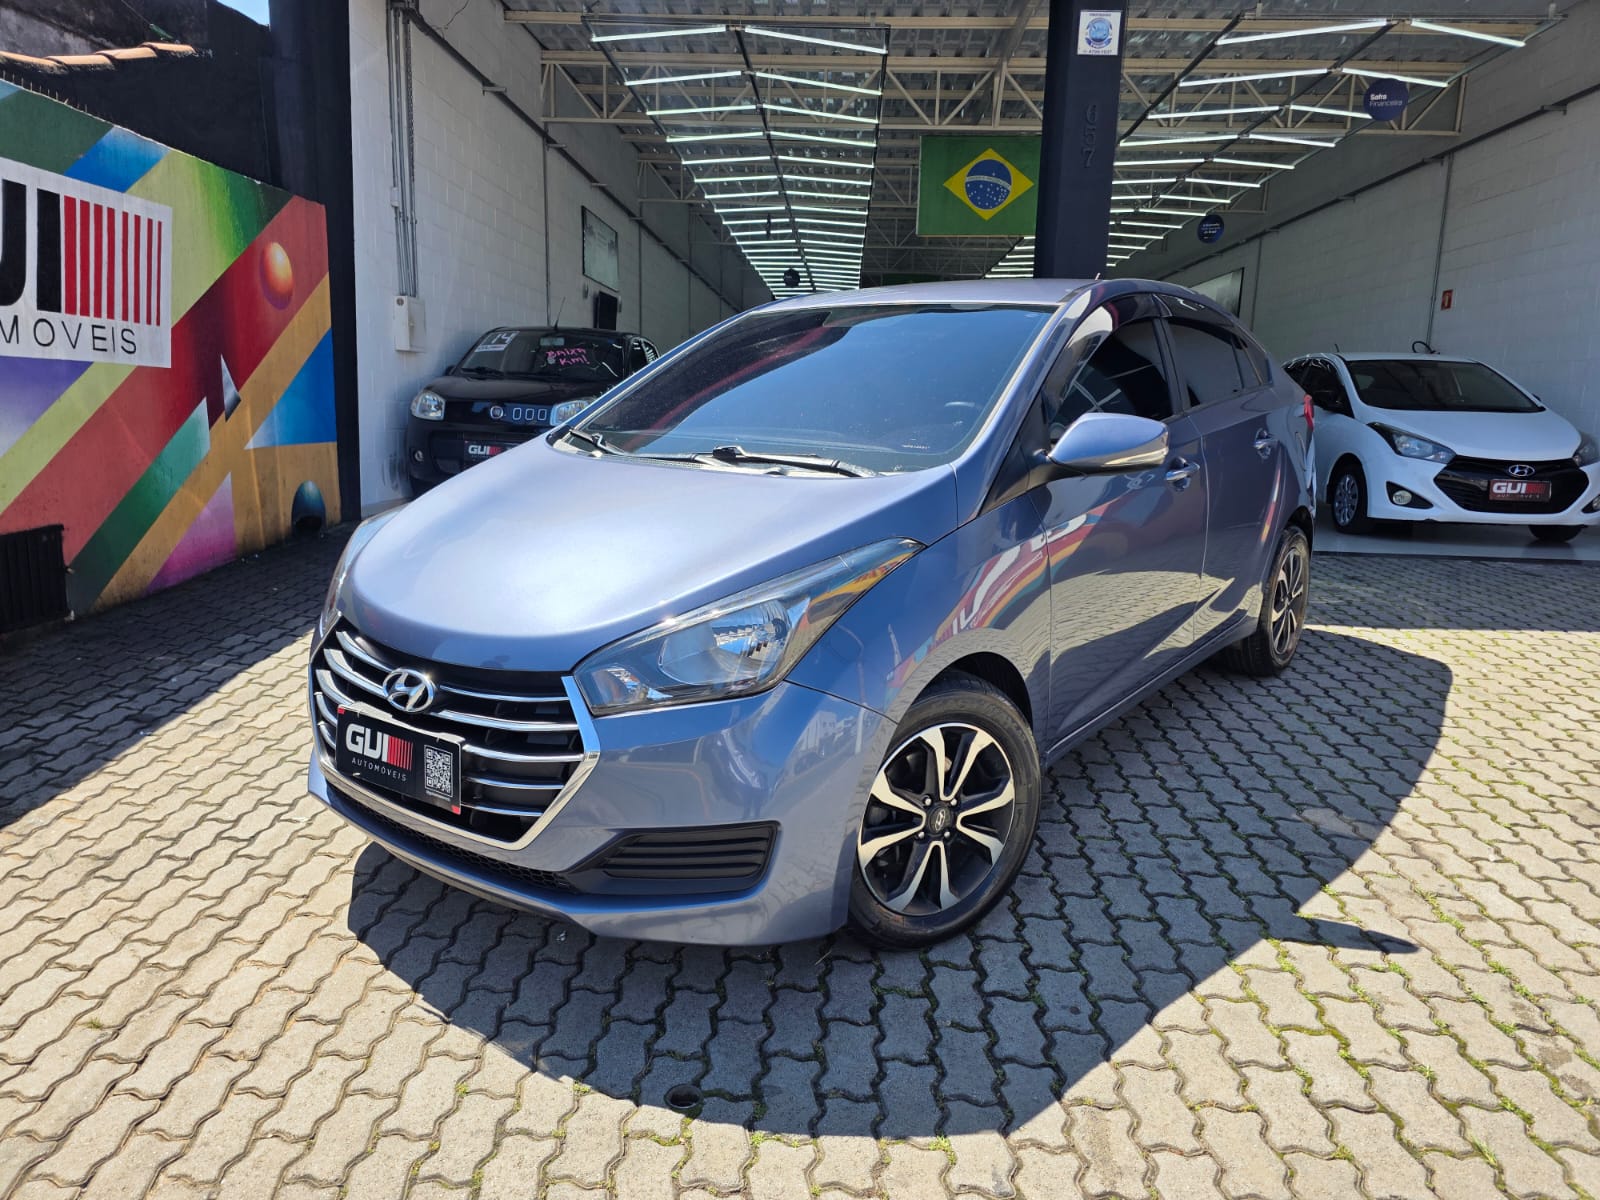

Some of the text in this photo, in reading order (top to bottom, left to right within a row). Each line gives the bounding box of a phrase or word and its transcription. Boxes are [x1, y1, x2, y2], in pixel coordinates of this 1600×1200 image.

[468, 445, 490, 455] GUI
[1492, 482, 1527, 494] GUI
[346, 723, 389, 763] GUI
